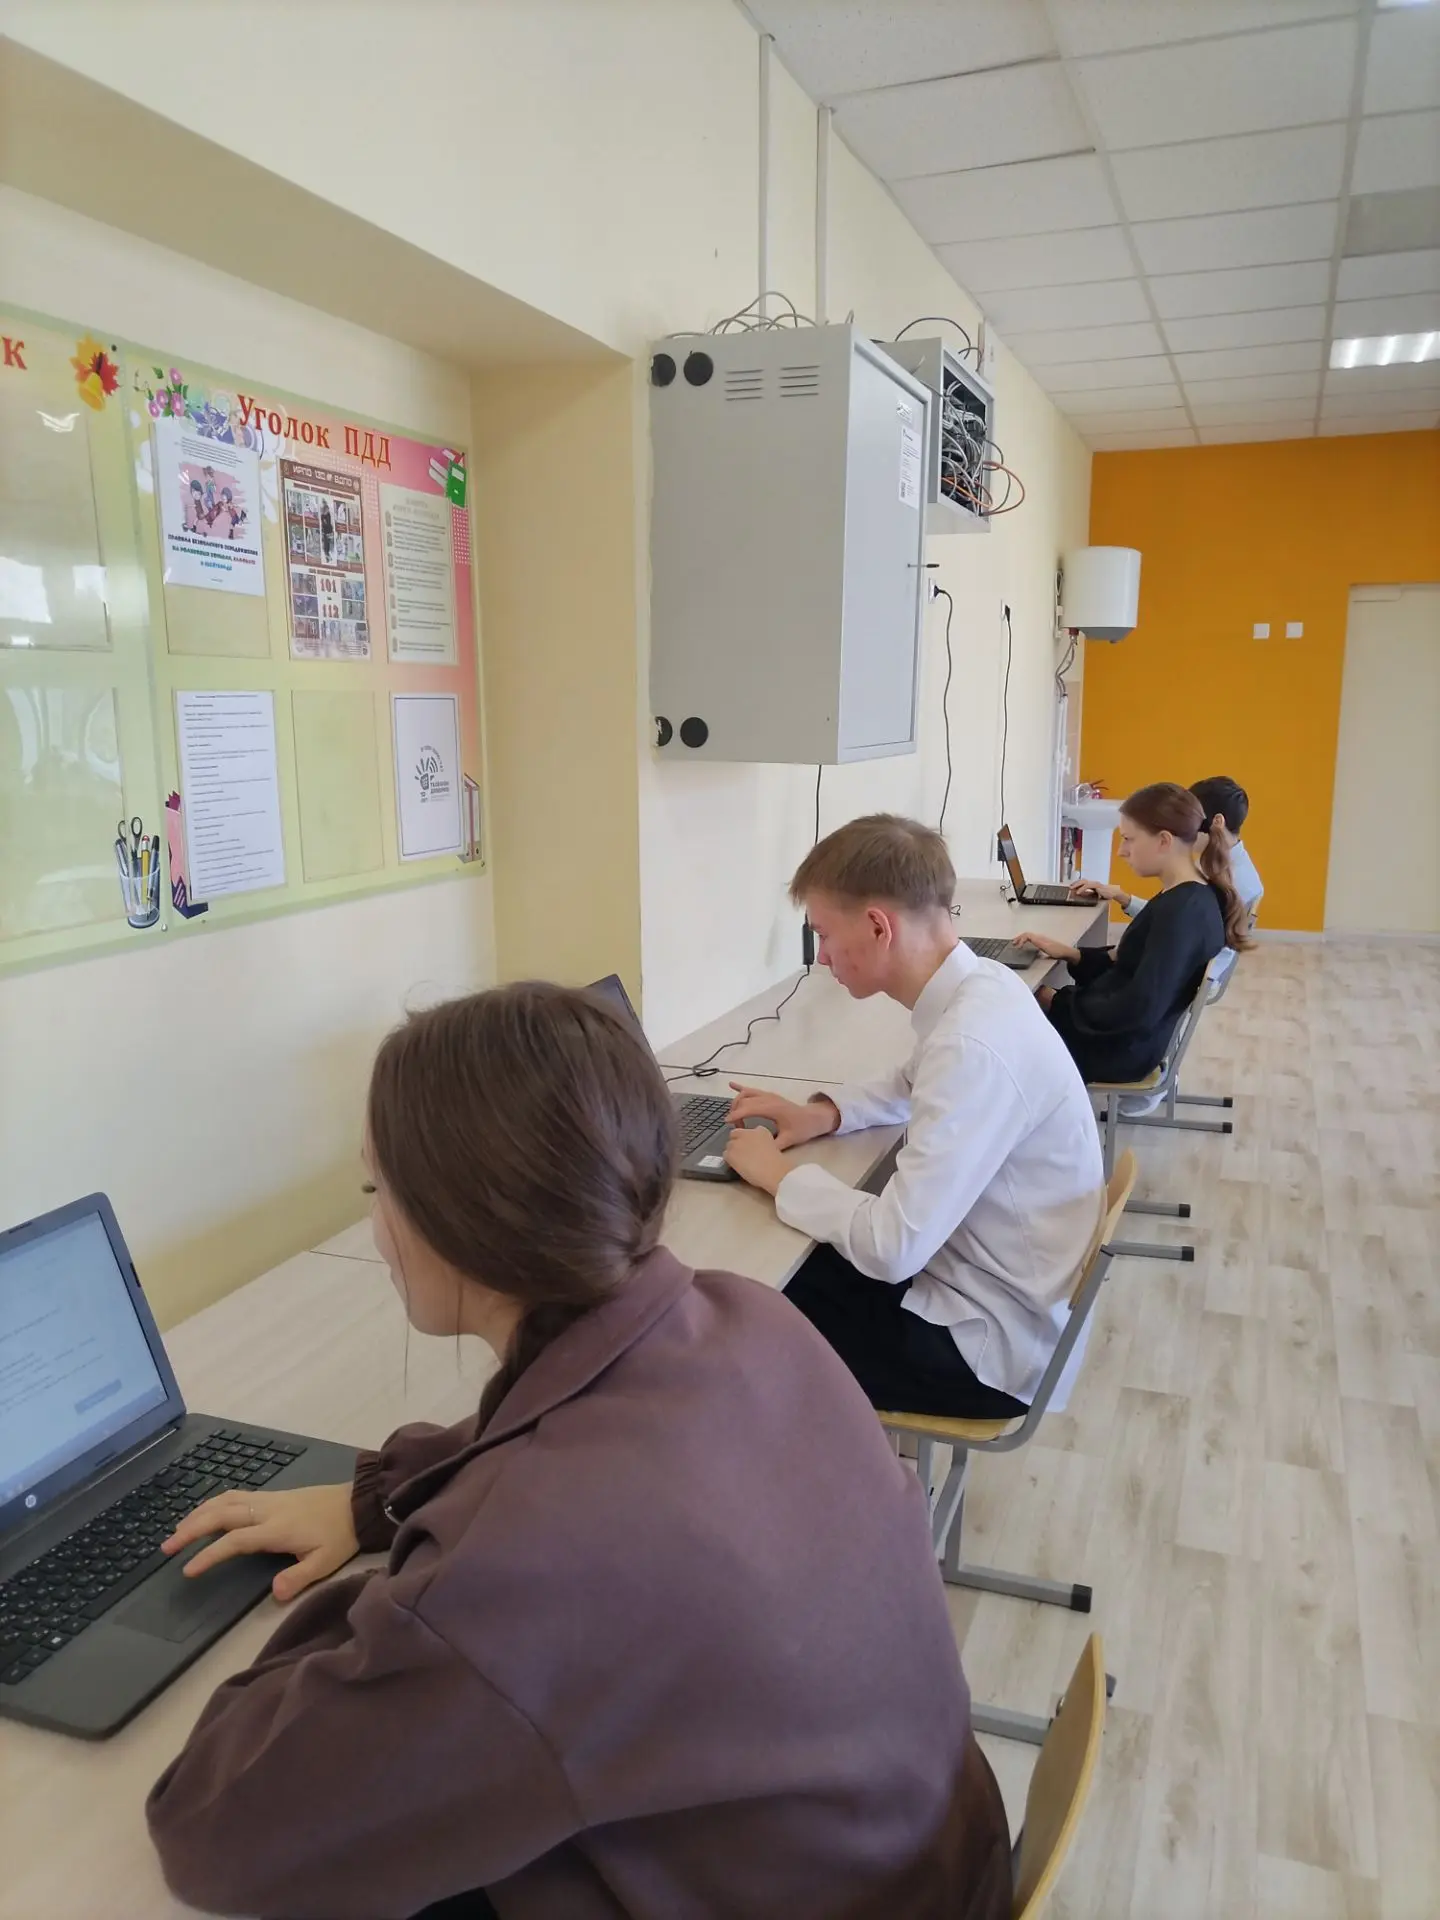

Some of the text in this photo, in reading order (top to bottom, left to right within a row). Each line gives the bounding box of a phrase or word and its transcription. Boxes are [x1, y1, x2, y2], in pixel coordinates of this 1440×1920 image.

[237, 394, 392, 471] Уголок ПДД
[320, 578, 337, 593] 101
[322, 604, 340, 618] 112
